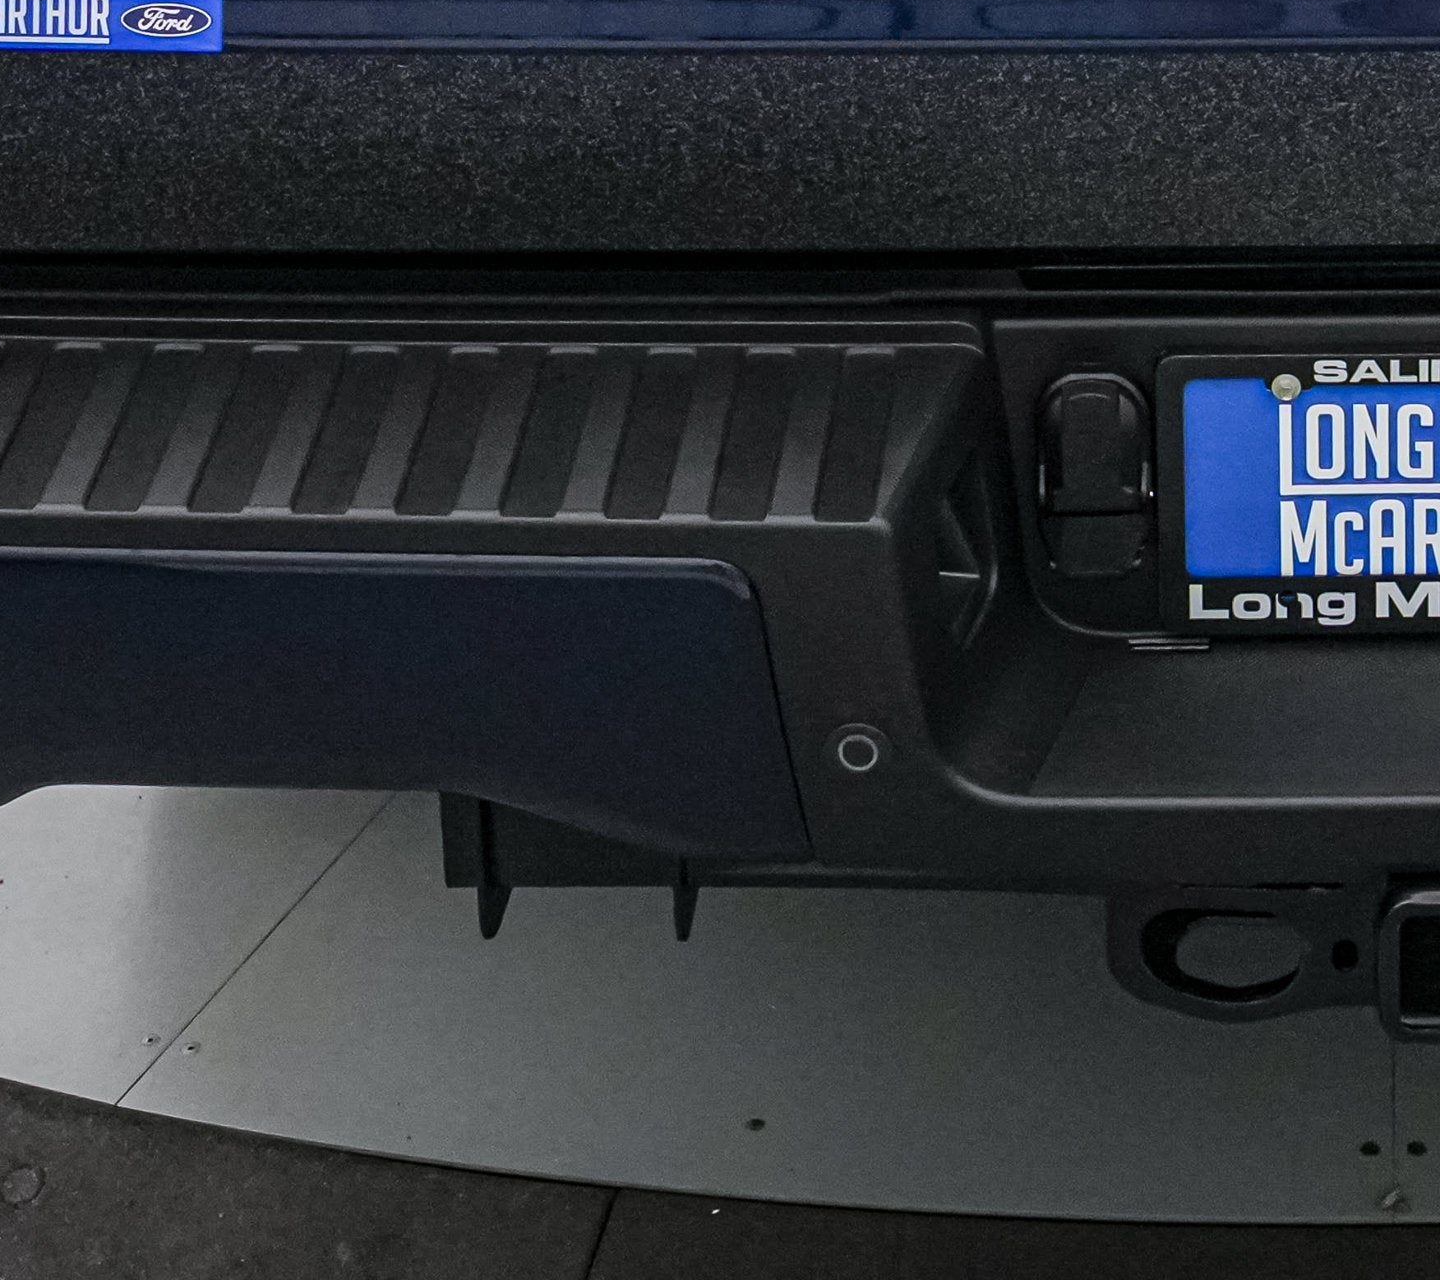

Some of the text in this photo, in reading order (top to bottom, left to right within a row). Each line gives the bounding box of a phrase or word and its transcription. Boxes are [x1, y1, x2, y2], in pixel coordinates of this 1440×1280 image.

[137, 6, 194, 33] Ford
[1278, 403, 1435, 496] LONG
[1188, 583, 1357, 626] Long
